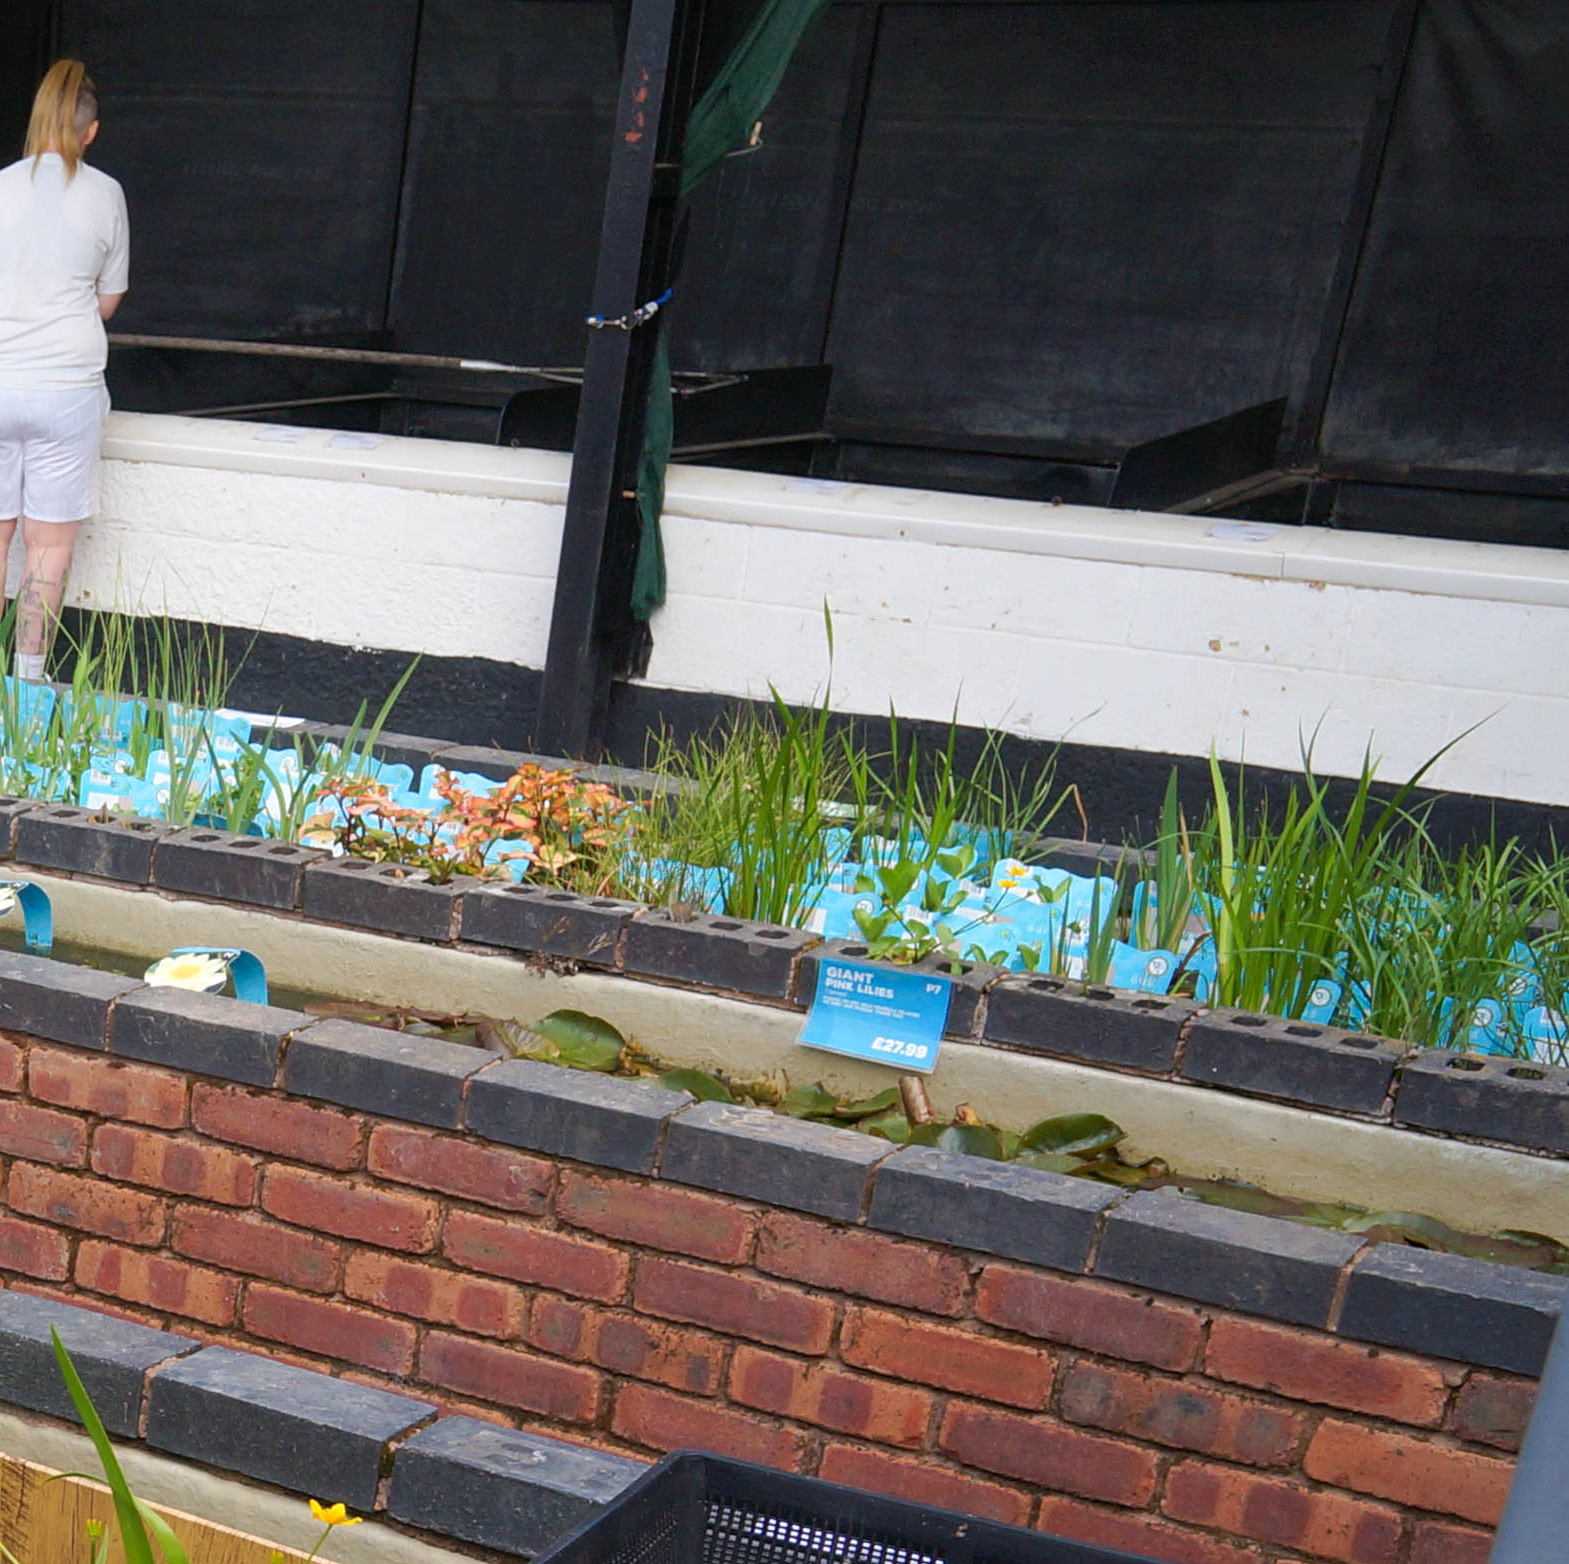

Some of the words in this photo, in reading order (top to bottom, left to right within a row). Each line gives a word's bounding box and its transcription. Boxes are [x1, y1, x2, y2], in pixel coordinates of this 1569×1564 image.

[825, 965, 875, 985] GIANT
[824, 977, 854, 991] PINK
[857, 982, 895, 999] LILIES
[924, 982, 943, 995] P7
[870, 1036, 929, 1060] £27.99
